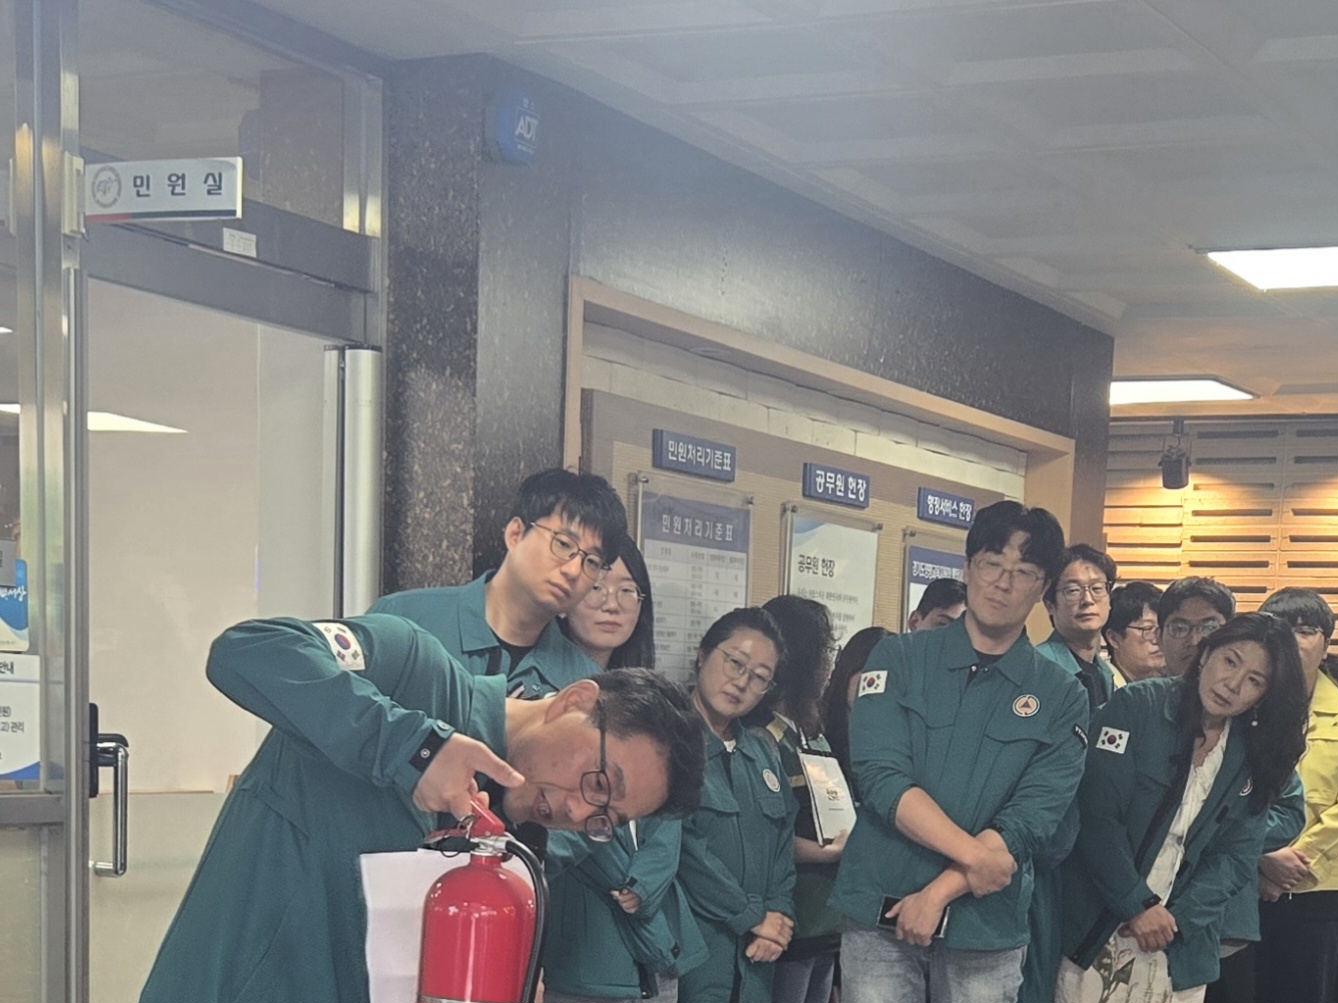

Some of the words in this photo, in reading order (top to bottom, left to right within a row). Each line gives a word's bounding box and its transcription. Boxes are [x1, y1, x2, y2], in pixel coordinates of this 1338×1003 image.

[667, 439, 732, 472] 민원처리기준표
[815, 469, 845, 497] 공무원
[847, 475, 867, 502] 헌장
[927, 494, 958, 518] 행정서비스
[661, 513, 734, 542] 민원처리기준표
[797, 554, 819, 575] 공무원
